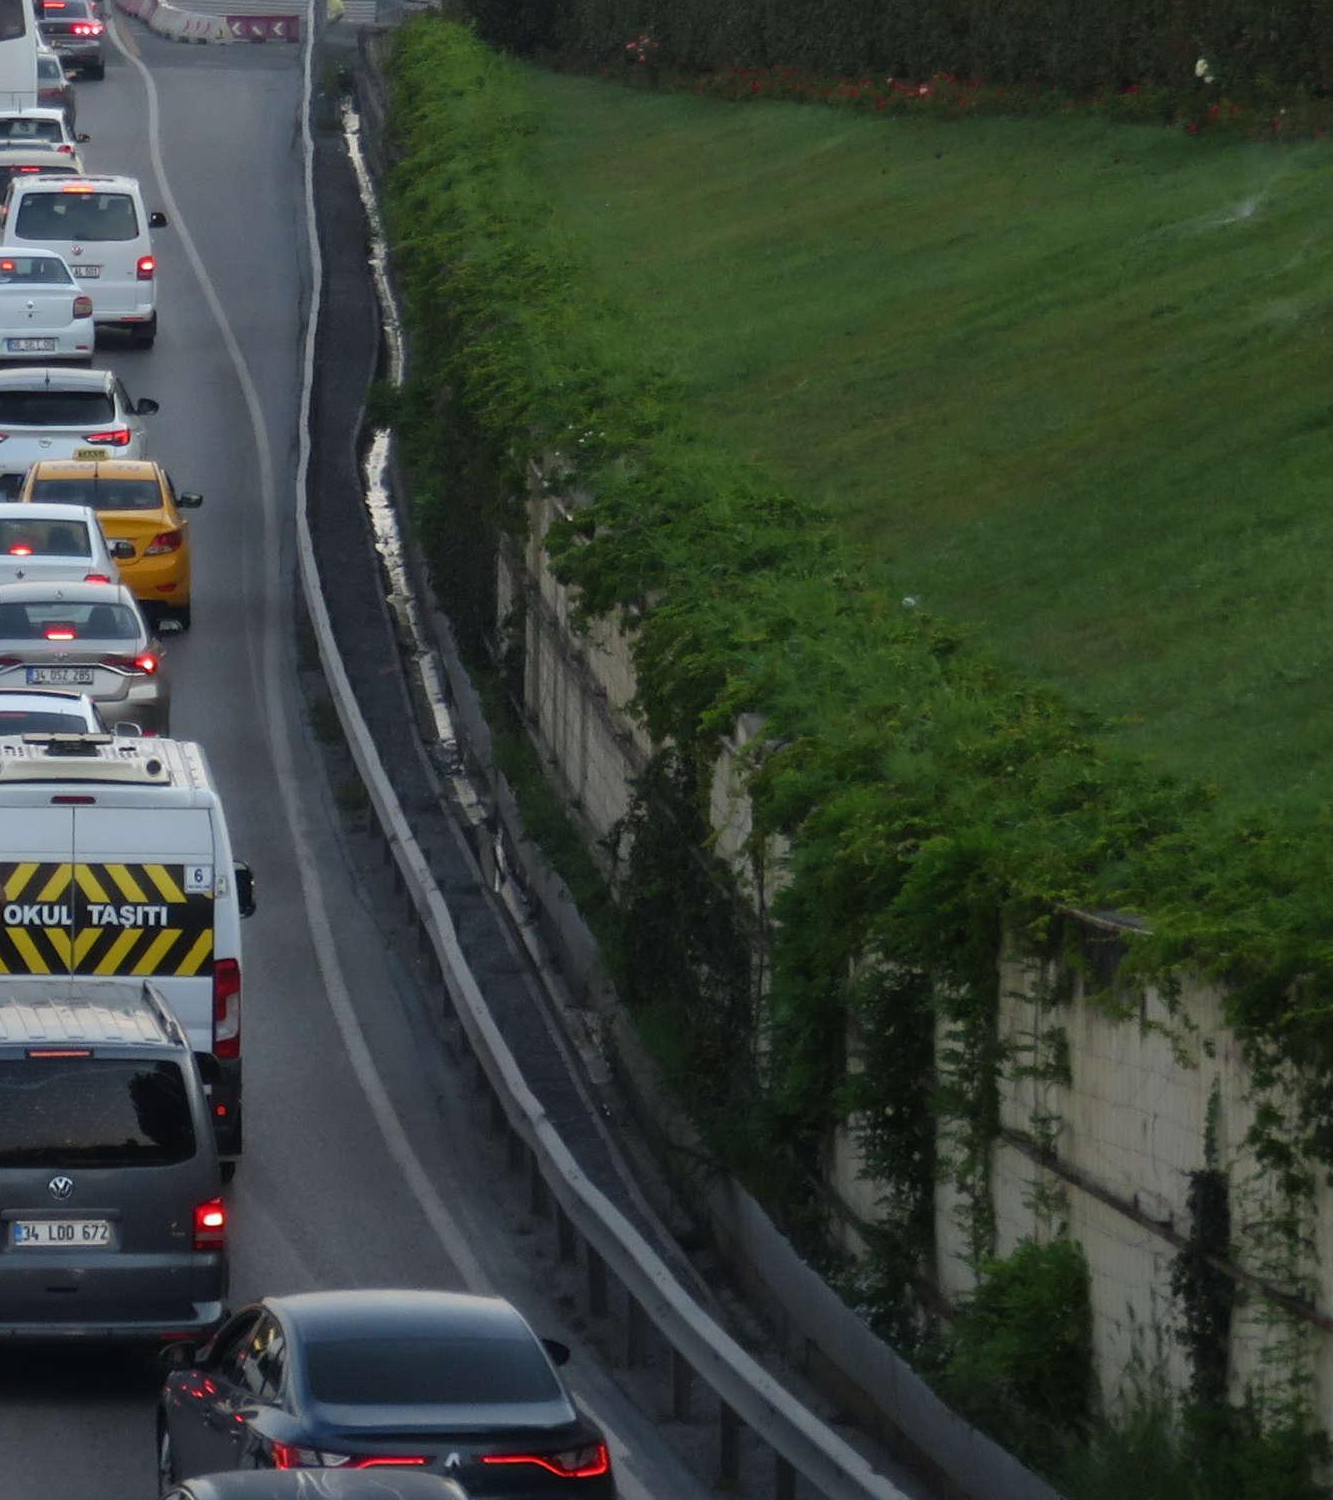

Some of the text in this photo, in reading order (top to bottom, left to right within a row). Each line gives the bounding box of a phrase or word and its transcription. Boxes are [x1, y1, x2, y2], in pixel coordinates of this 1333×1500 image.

[35, 668, 46, 680] 34
[194, 868, 203, 882] 6
[4, 905, 169, 929] OKUL TAŞITI
[22, 1225, 39, 1242] 34
[81, 1223, 108, 1241] 672
